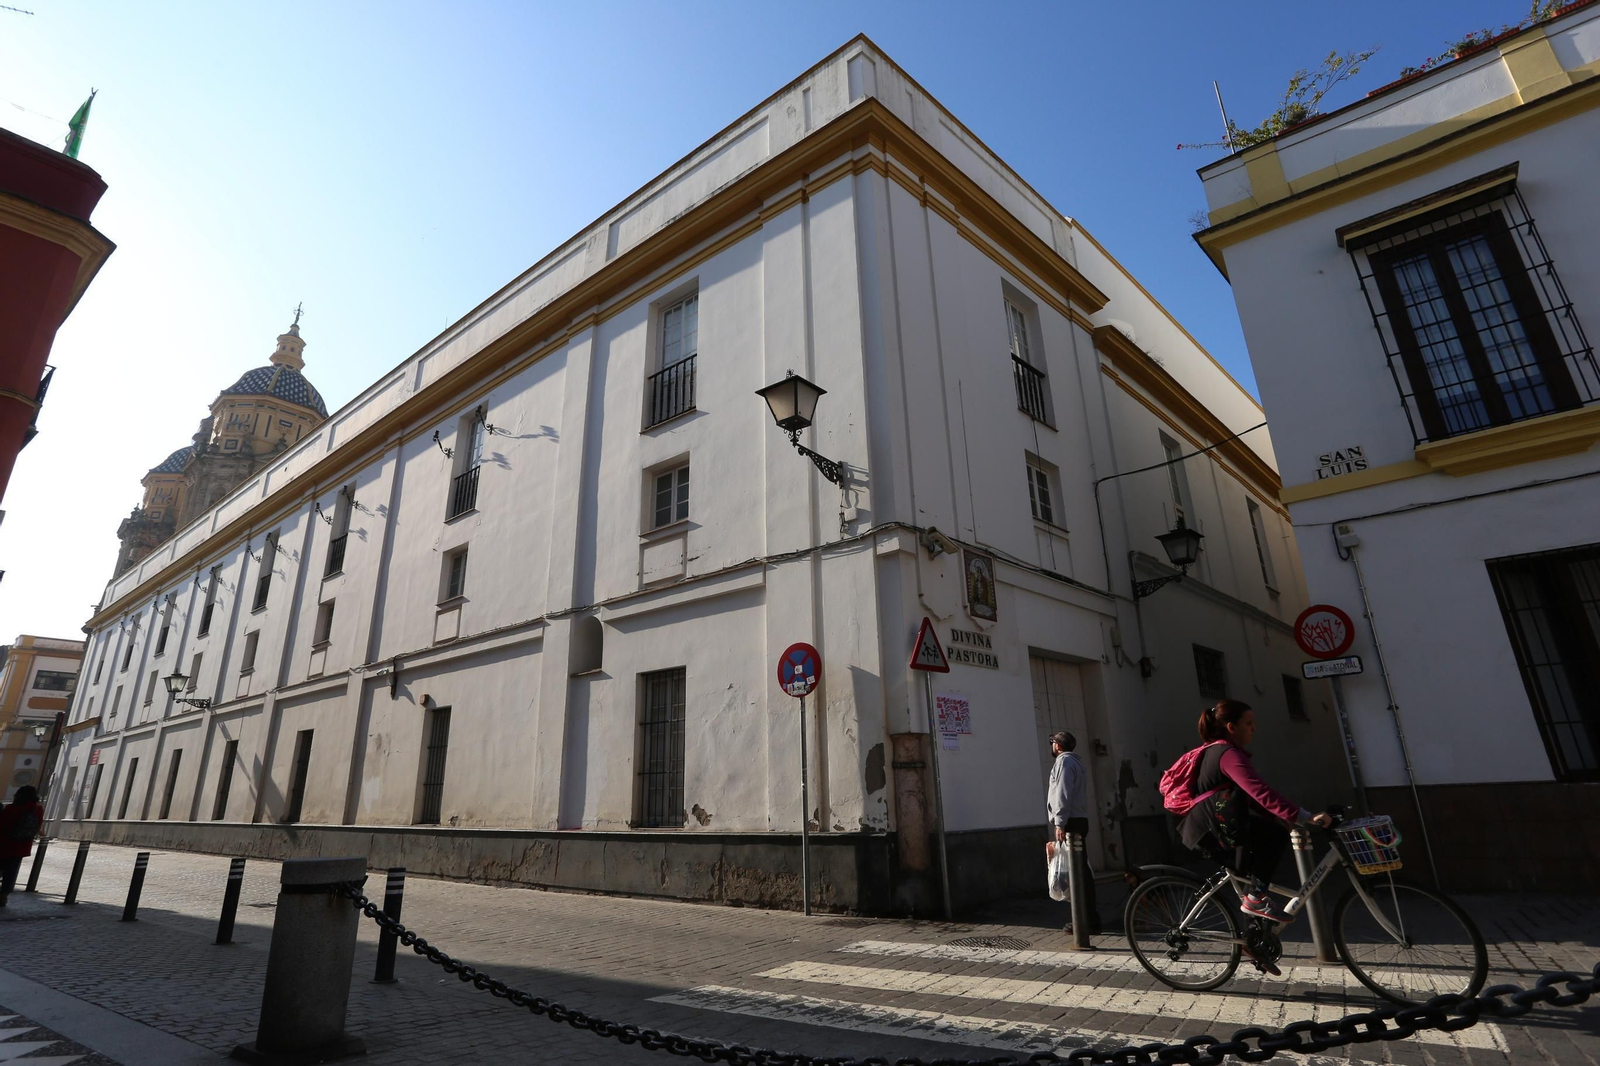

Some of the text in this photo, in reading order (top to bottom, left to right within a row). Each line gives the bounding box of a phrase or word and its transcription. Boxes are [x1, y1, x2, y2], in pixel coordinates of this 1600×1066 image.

[1319, 446, 1362, 466] SAN
[1316, 459, 1367, 480] LUIS
[951, 628, 992, 649] DIVINA
[947, 647, 999, 668] PASTORA
